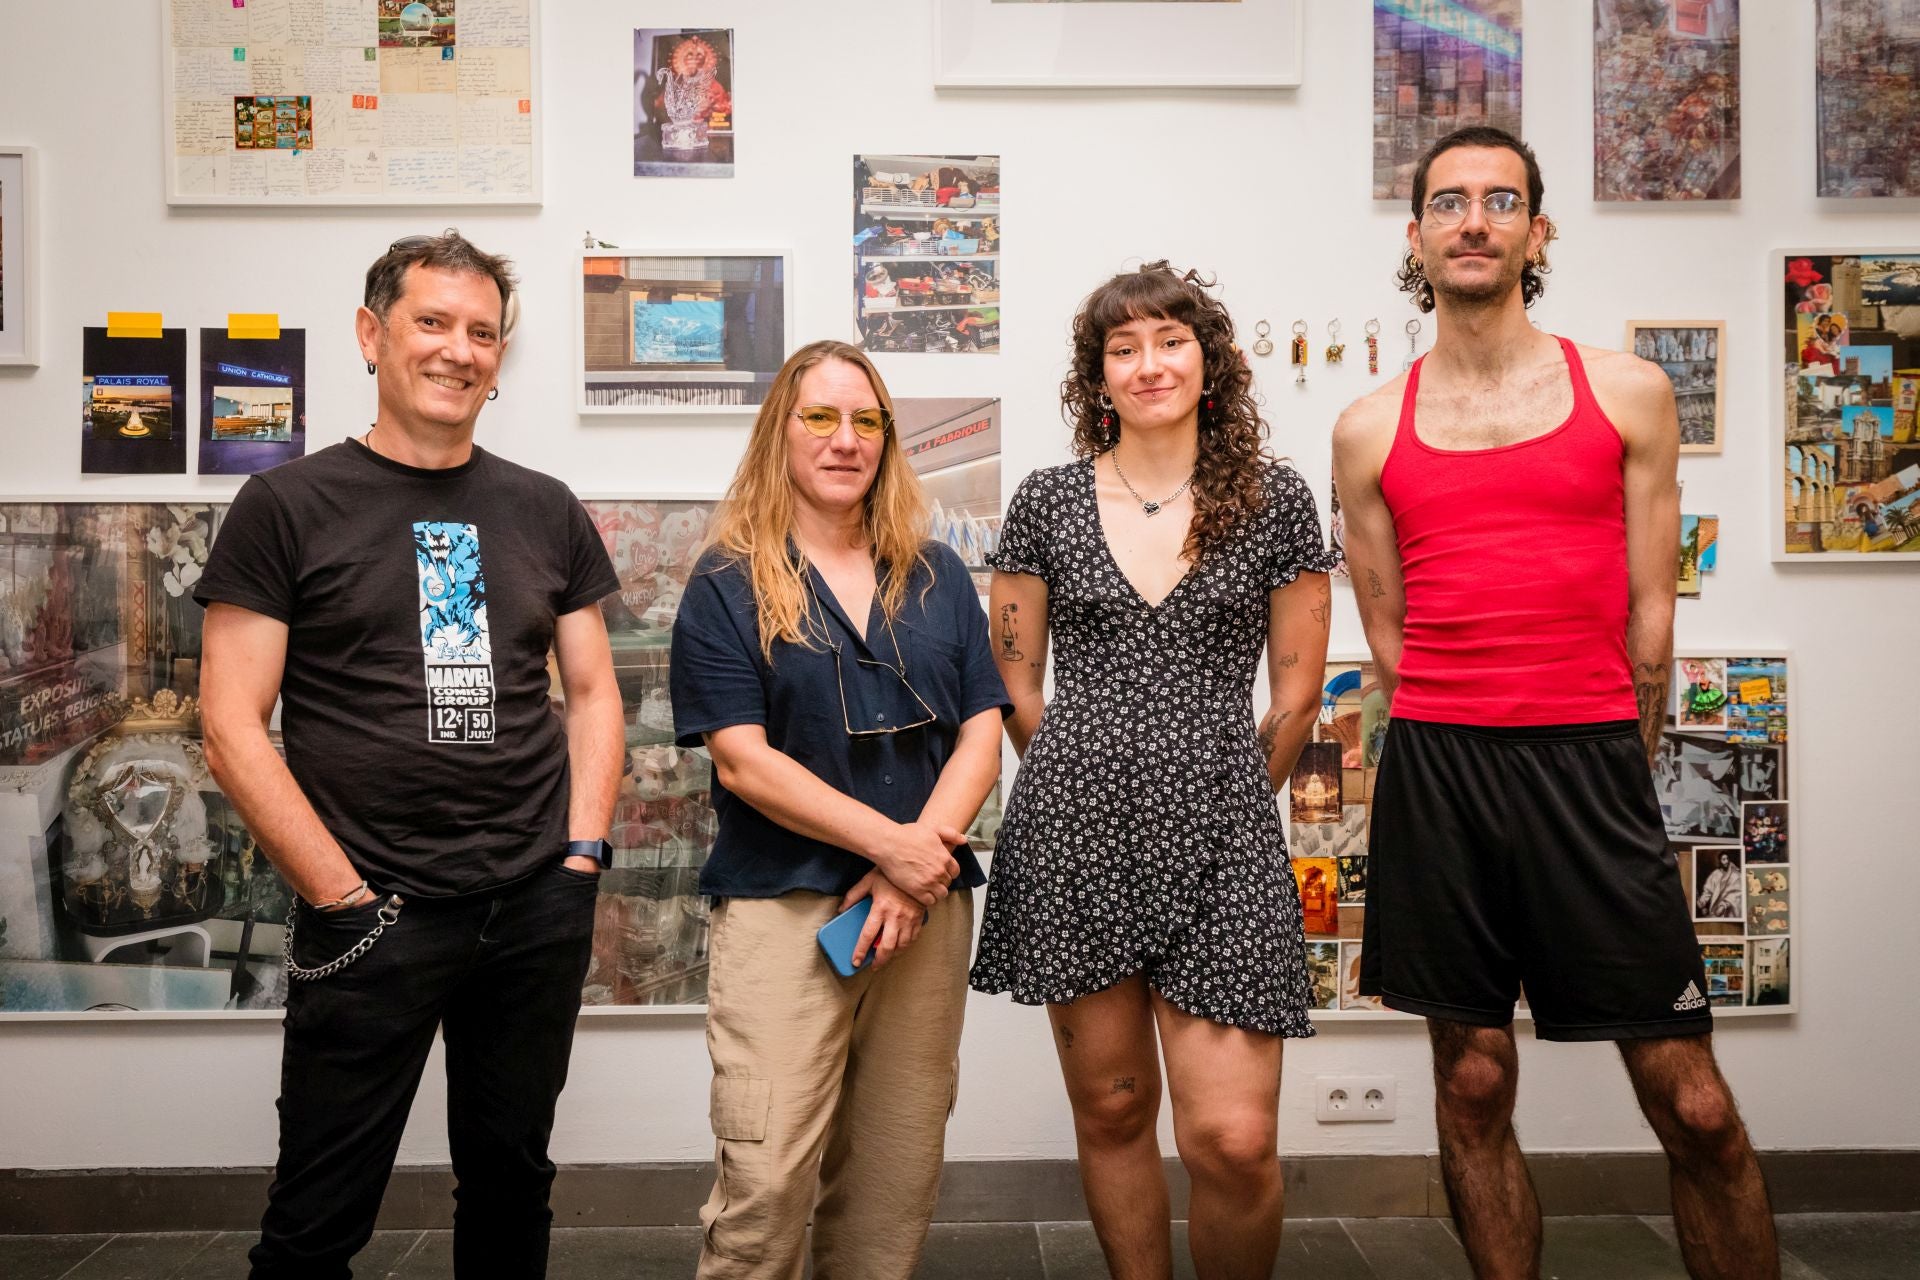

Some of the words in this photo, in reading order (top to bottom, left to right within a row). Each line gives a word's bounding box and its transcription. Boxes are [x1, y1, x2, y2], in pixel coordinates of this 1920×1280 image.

[221, 365, 247, 376] UNION
[98, 377, 132, 386] PALAIS
[136, 377, 166, 386] ROYAL
[918, 440, 931, 452] LA
[933, 420, 989, 447] FABRIQUE
[437, 643, 481, 660] VENOM
[428, 667, 492, 688] MARVEL
[433, 687, 489, 696] COMICS
[433, 696, 490, 706] GROUP
[436, 707, 463, 729] 12¢
[472, 712, 489, 729] 50
[0, 709, 60, 752] TATUES
[440, 730, 457, 738] IND.
[468, 730, 492, 739] JULY
[1673, 997, 1707, 1011] adidas
